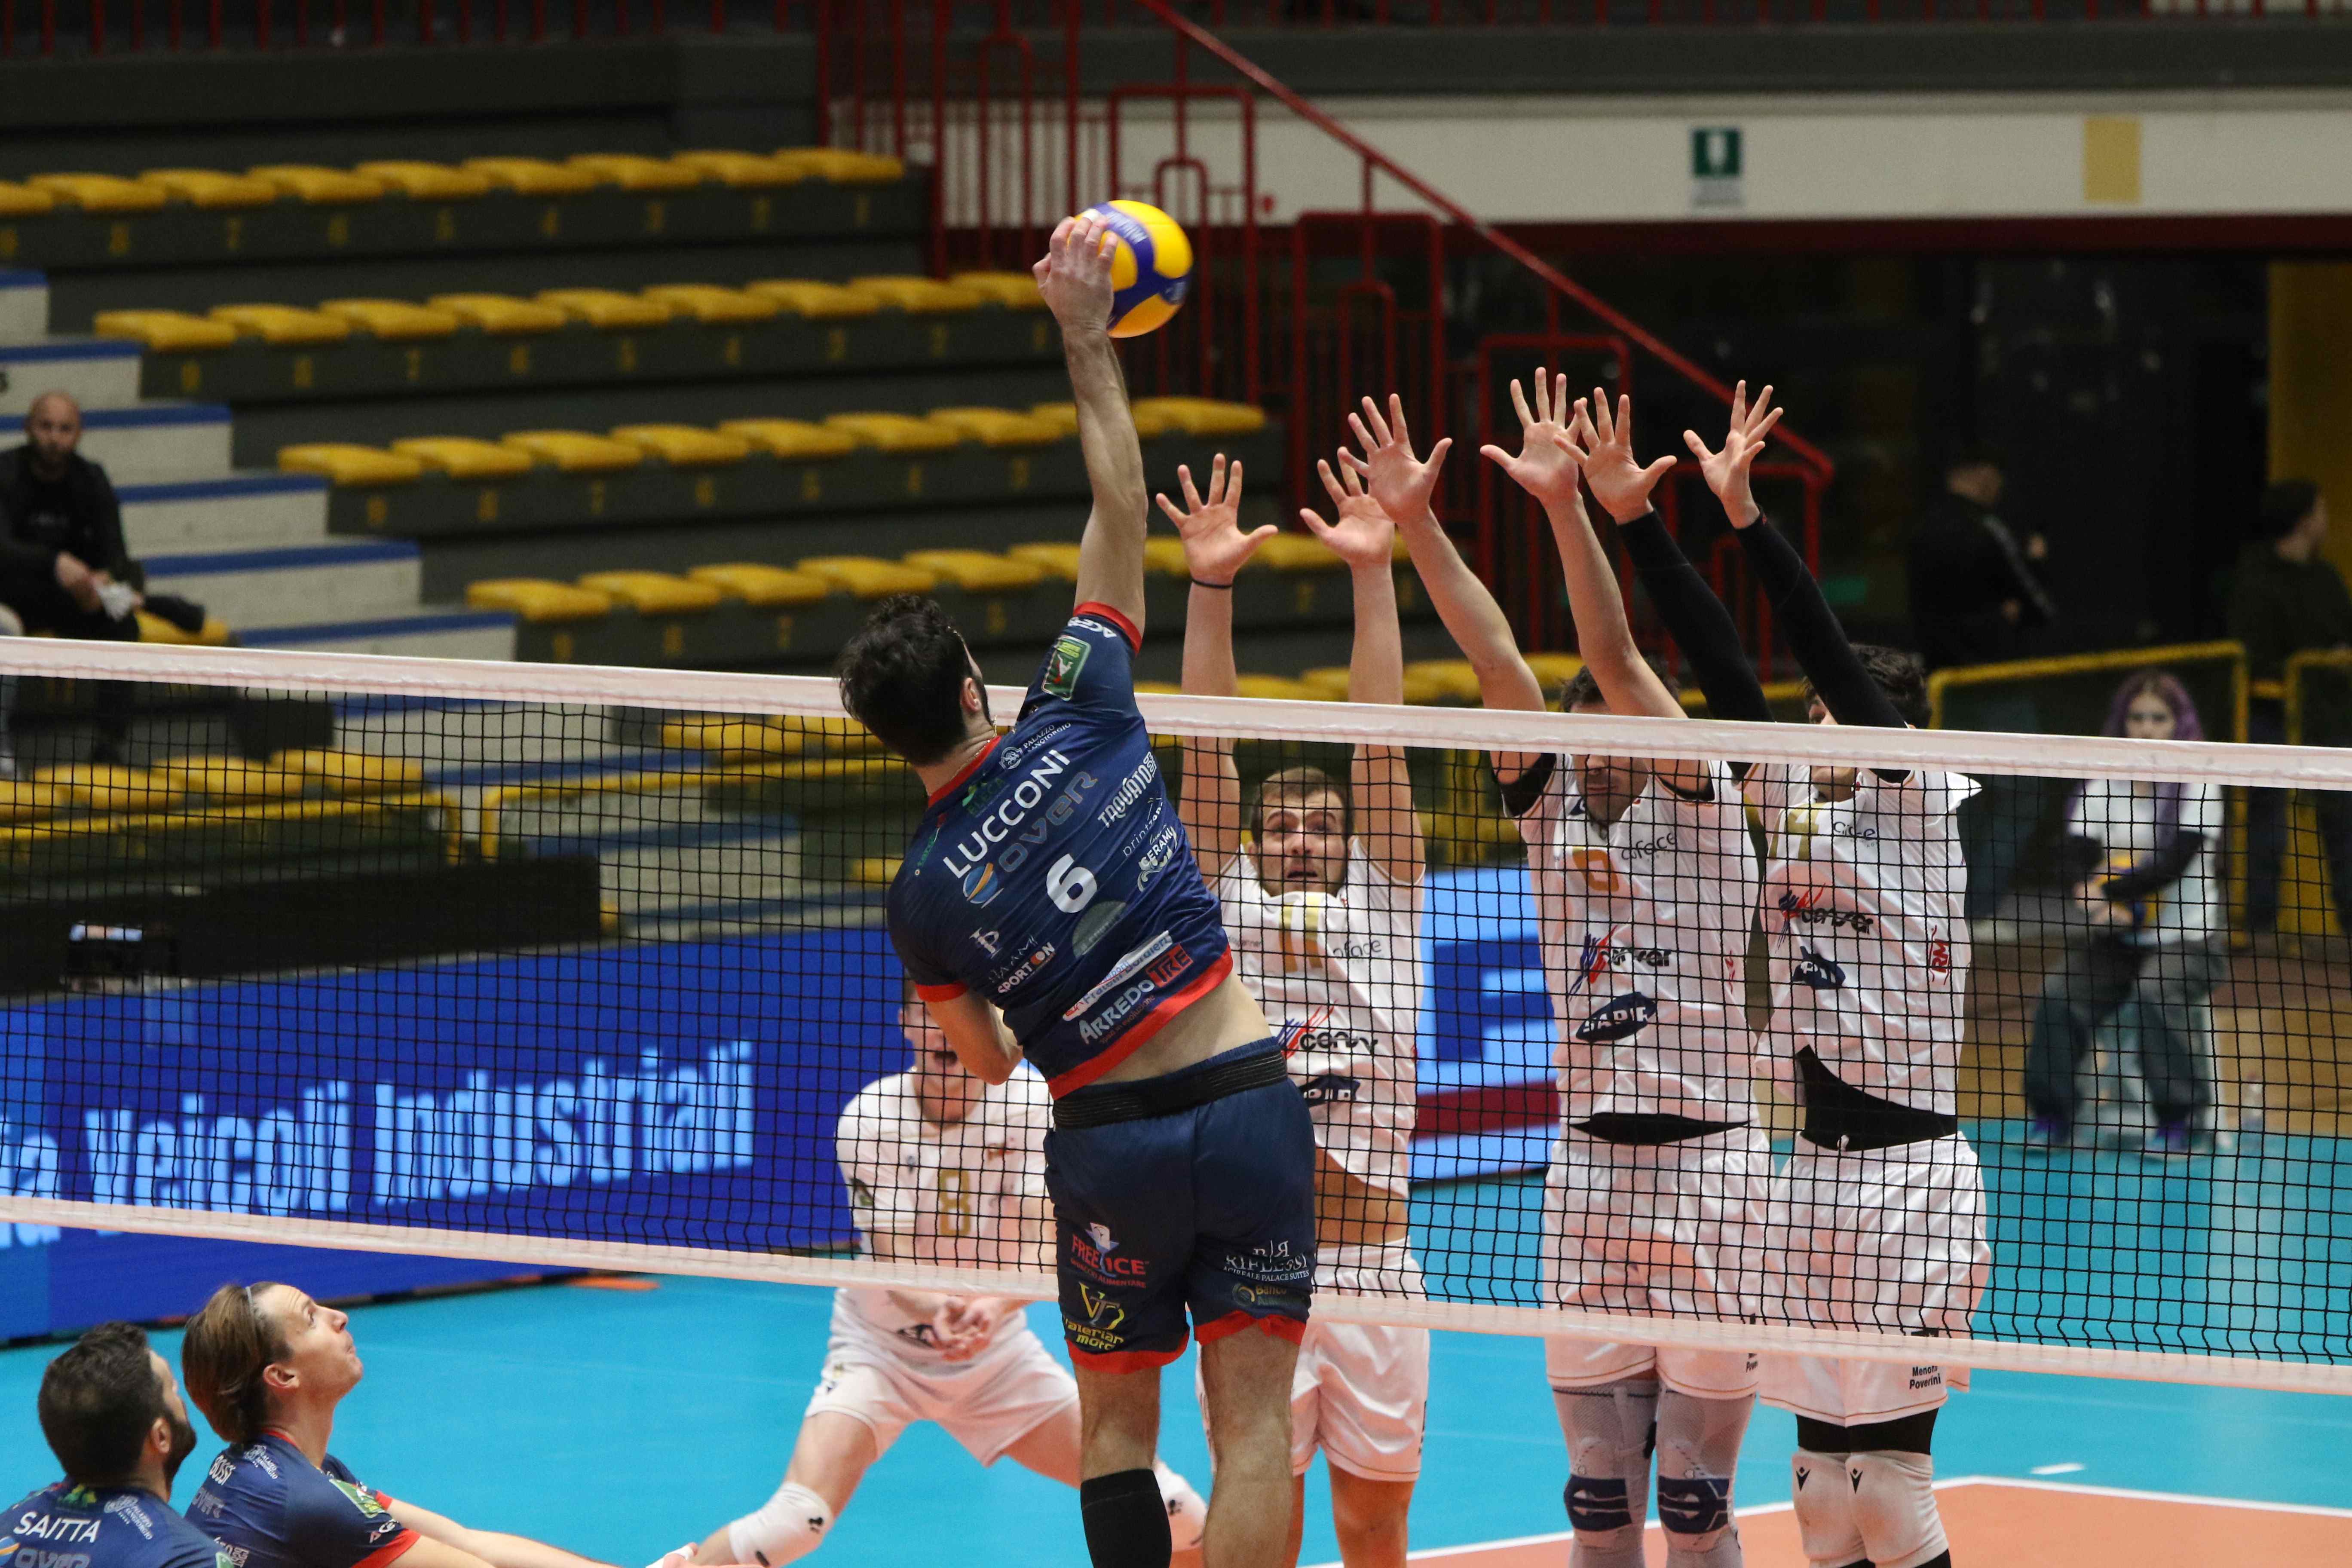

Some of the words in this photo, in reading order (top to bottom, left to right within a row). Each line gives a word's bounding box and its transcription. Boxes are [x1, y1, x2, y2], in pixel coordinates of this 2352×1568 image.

[1023, 725, 1055, 748] PALAZZO
[943, 749, 1070, 879] LUCCONI
[1047, 854, 1097, 913] 6
[1079, 980, 1155, 1044] ARREDO
[84, 1080, 352, 1236] Veicoli
[372, 1040, 754, 1209] Industriali
[939, 1168, 971, 1237] 8
[1105, 1257, 1147, 1275] ICE
[1261, 1274, 1289, 1282] PALACE
[1289, 1270, 1310, 1280] SUITES
[13, 1512, 101, 1543] SAITTA
